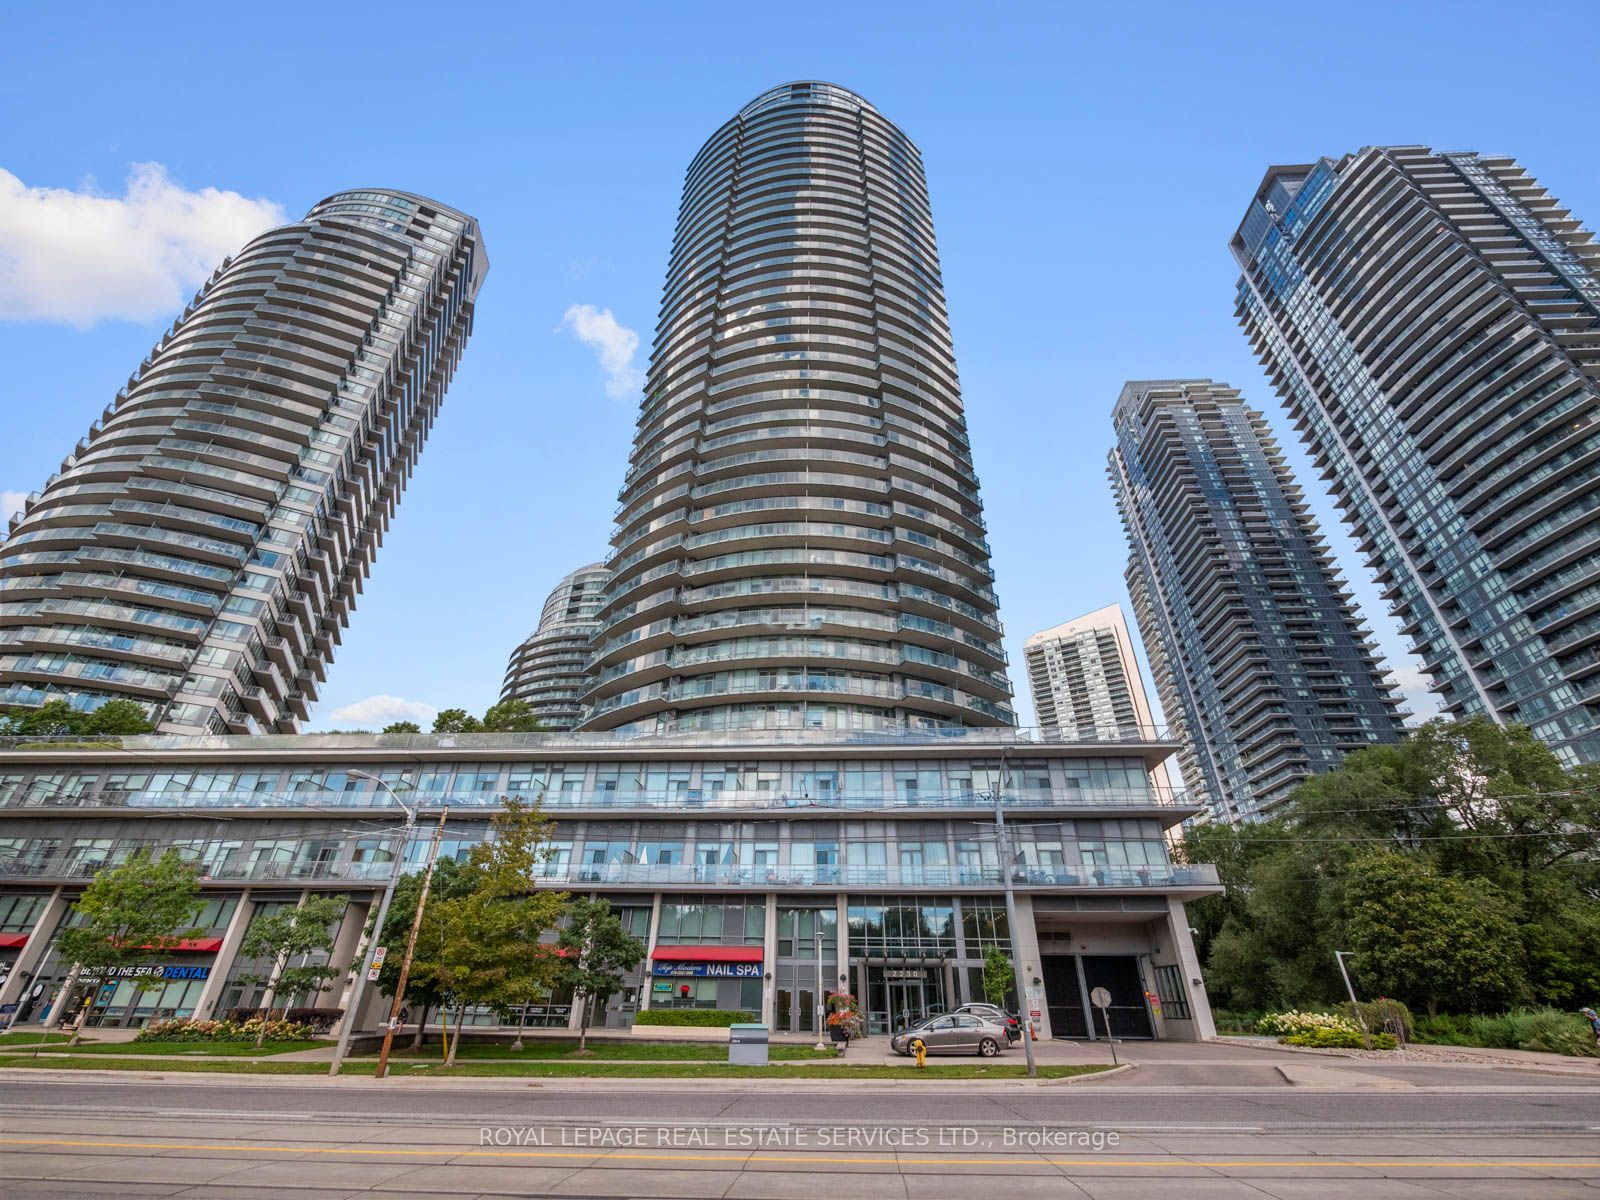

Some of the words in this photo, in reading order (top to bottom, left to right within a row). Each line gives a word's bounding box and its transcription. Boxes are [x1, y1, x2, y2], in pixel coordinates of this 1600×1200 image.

[117, 967, 135, 976] THE
[134, 966, 152, 976] SEA
[164, 967, 208, 978] DENTAL
[706, 965, 733, 975] NAIL
[736, 965, 760, 975] SPA
